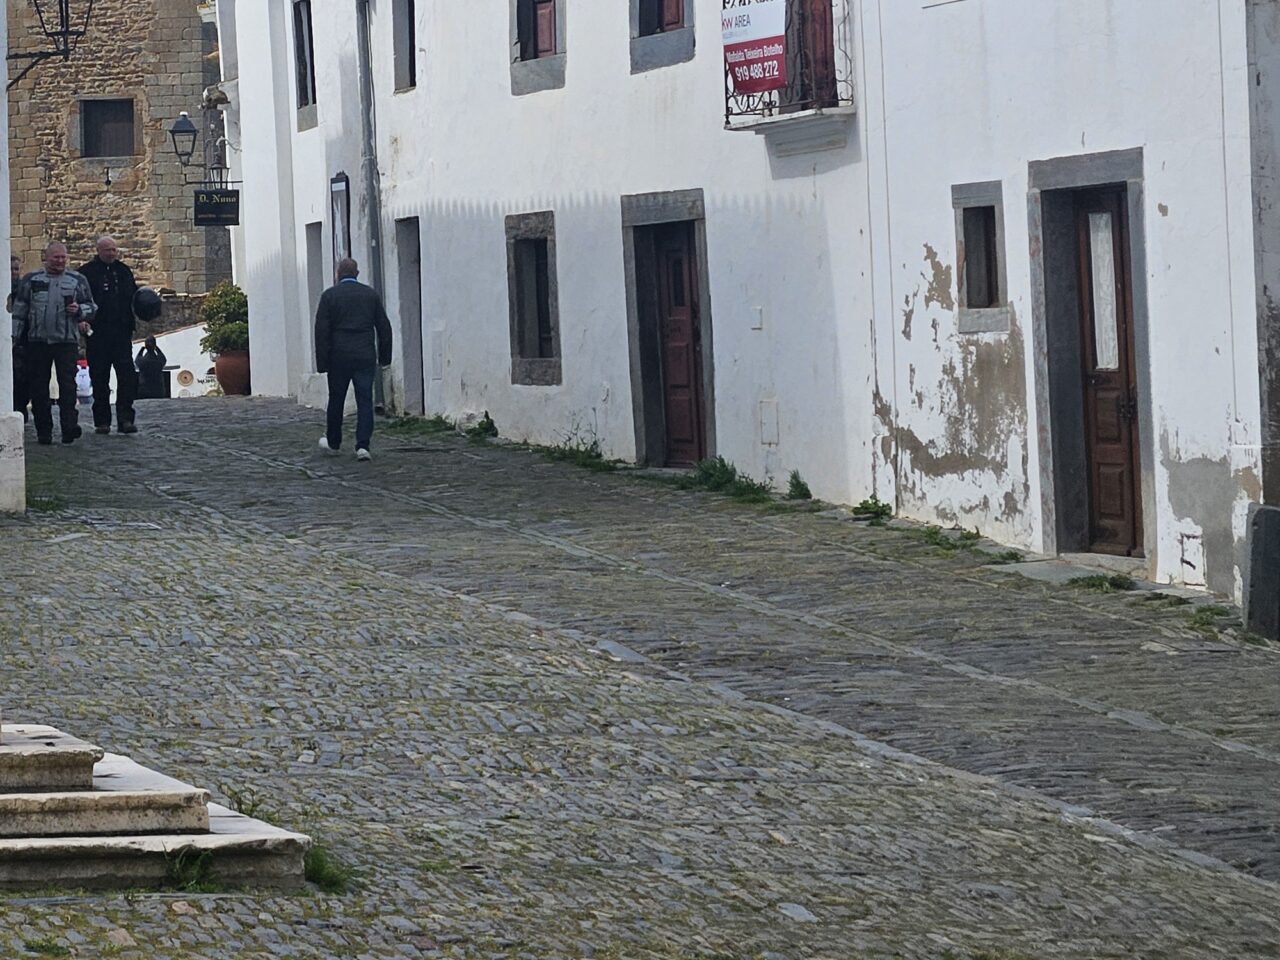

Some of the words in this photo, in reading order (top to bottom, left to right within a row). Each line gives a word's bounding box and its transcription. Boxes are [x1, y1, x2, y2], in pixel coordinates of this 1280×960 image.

[734, 14, 751, 28] AREA
[735, 65, 749, 81] 919
[750, 63, 764, 79] 488
[763, 60, 779, 77] 272
